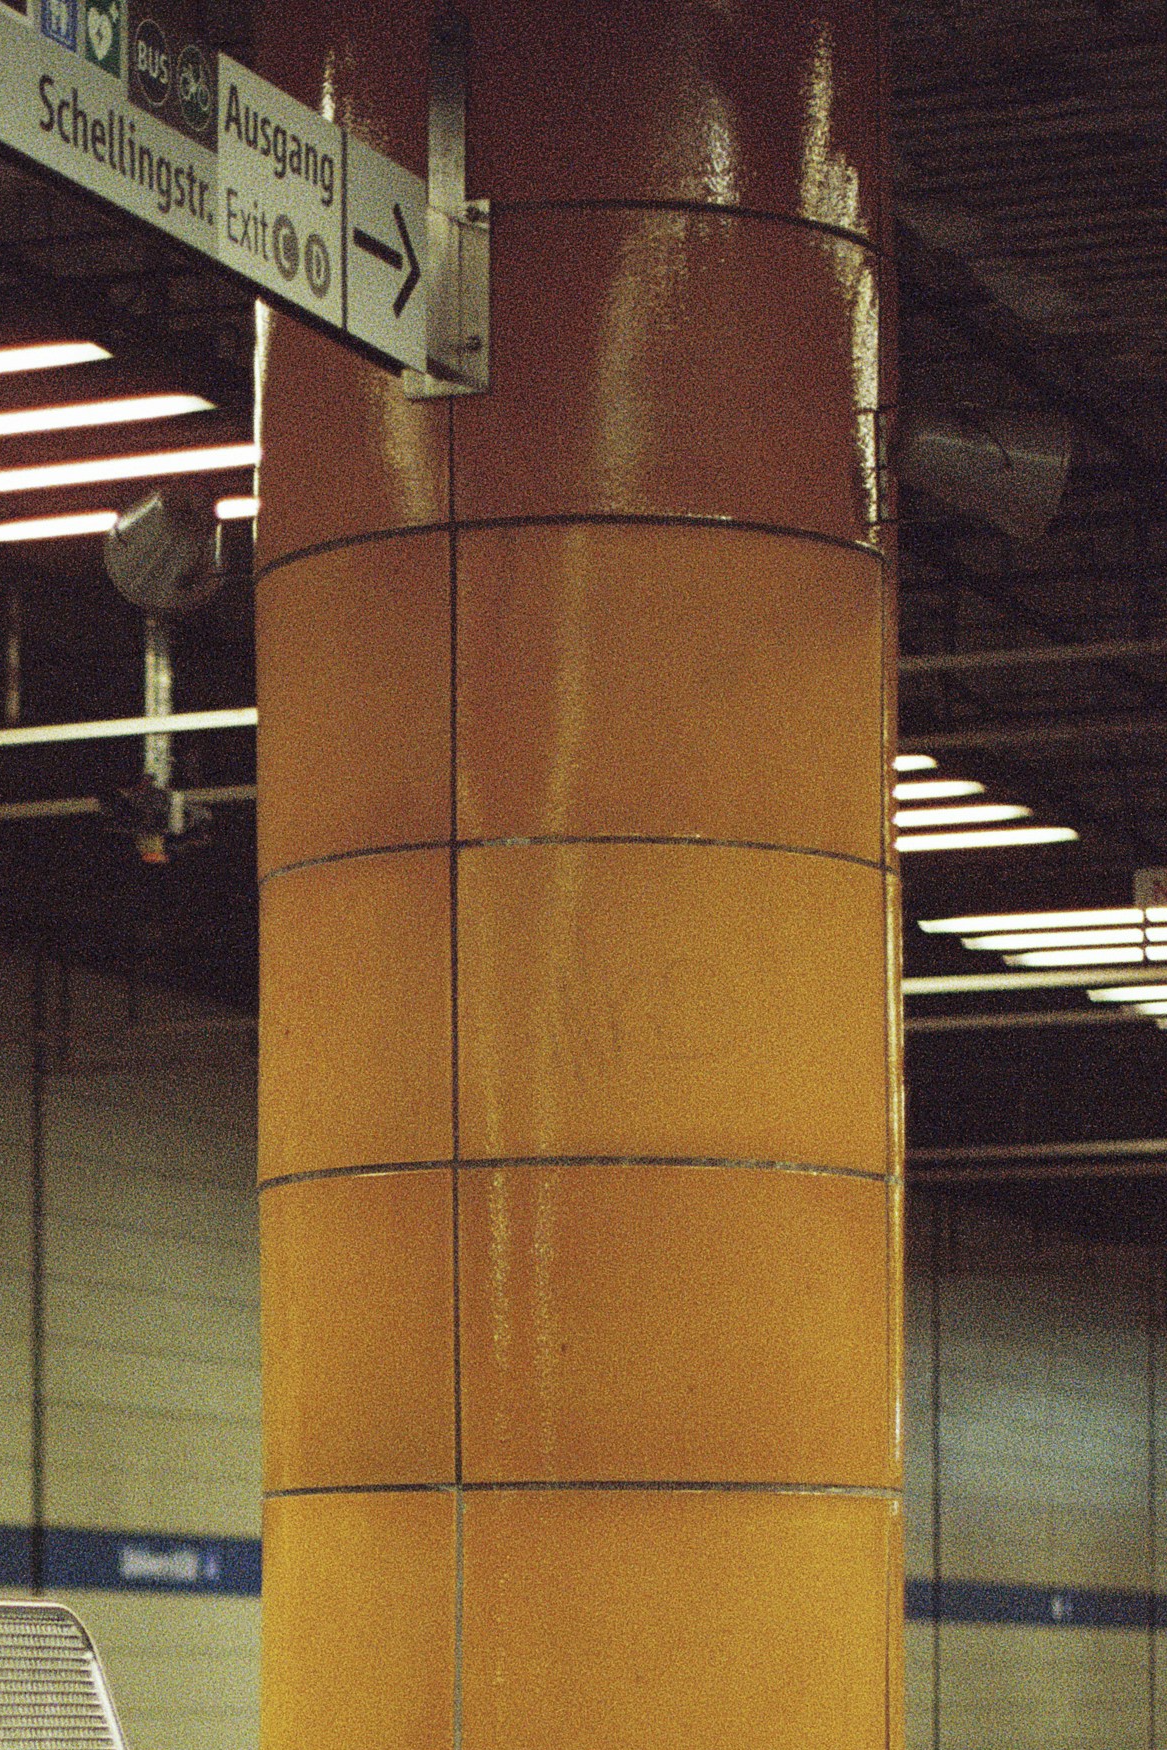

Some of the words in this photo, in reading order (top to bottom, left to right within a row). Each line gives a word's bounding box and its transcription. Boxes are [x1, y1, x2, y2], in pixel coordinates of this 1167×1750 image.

[136, 41, 169, 83] BUS
[38, 75, 214, 224] Schellingstr.
[224, 84, 335, 206] Ausgang
[226, 187, 269, 261] Exit
